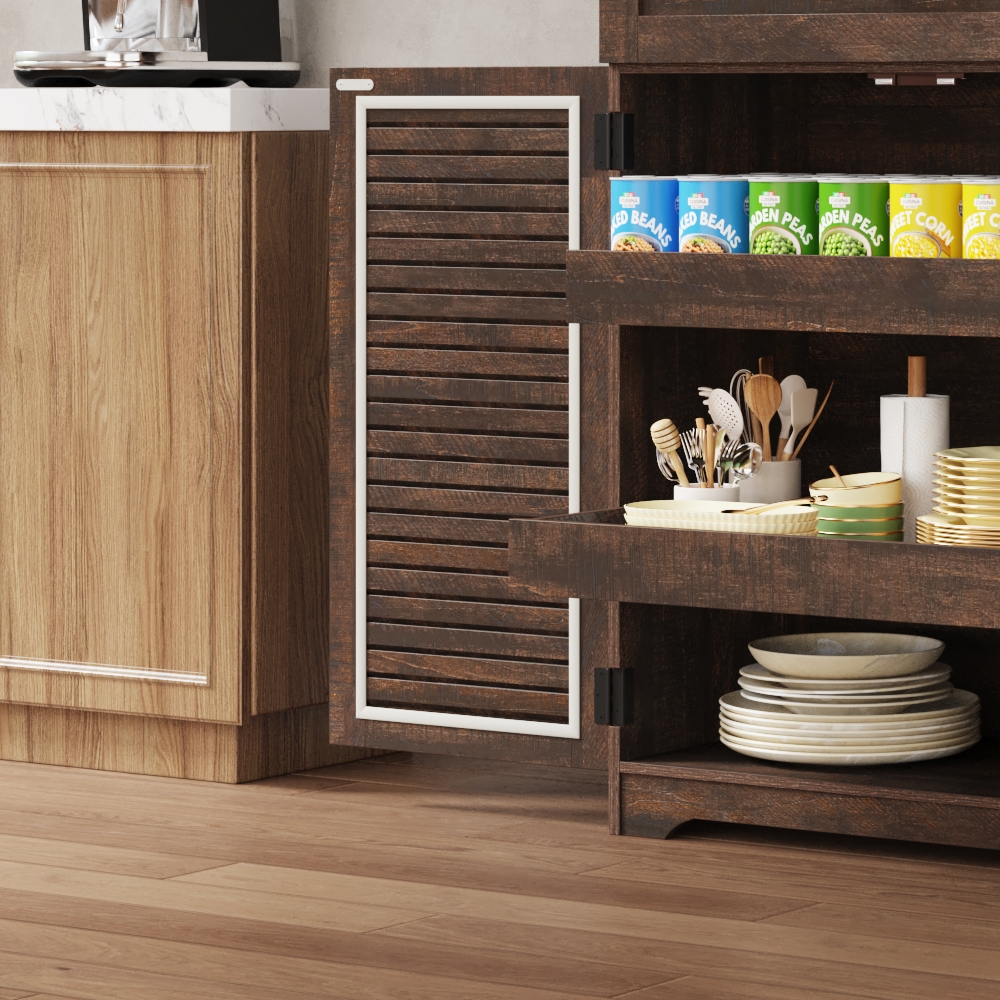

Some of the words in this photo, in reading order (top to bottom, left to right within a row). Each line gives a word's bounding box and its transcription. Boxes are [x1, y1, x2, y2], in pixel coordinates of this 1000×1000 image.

[611, 210, 628, 233] KED
[630, 209, 672, 247] BEANS
[679, 211, 697, 234] KED
[699, 211, 742, 249] BEANS
[750, 207, 780, 232] RDEN
[781, 211, 813, 246] PEAS
[820, 209, 850, 233] RDEN
[852, 212, 884, 247] PEAS
[889, 210, 912, 238] WEET
[915, 212, 955, 247] CORN
[963, 211, 986, 239] WEET
